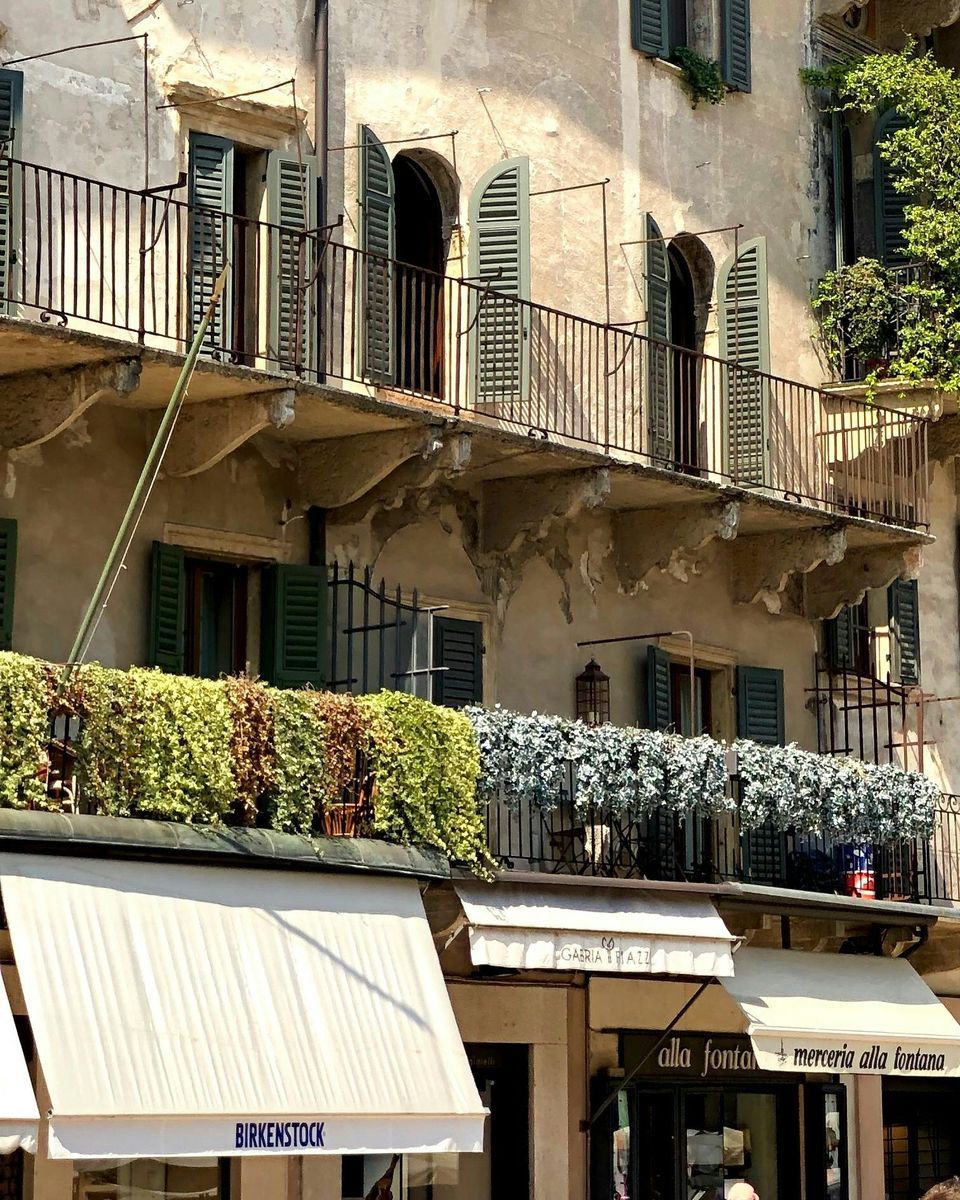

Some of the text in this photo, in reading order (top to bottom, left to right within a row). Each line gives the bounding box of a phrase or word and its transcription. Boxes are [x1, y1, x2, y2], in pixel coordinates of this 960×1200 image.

[658, 1037, 691, 1068] alla
[794, 1043, 945, 1071] merceria alla fontana
[235, 1122, 325, 1148] BIRKENSTOCK
